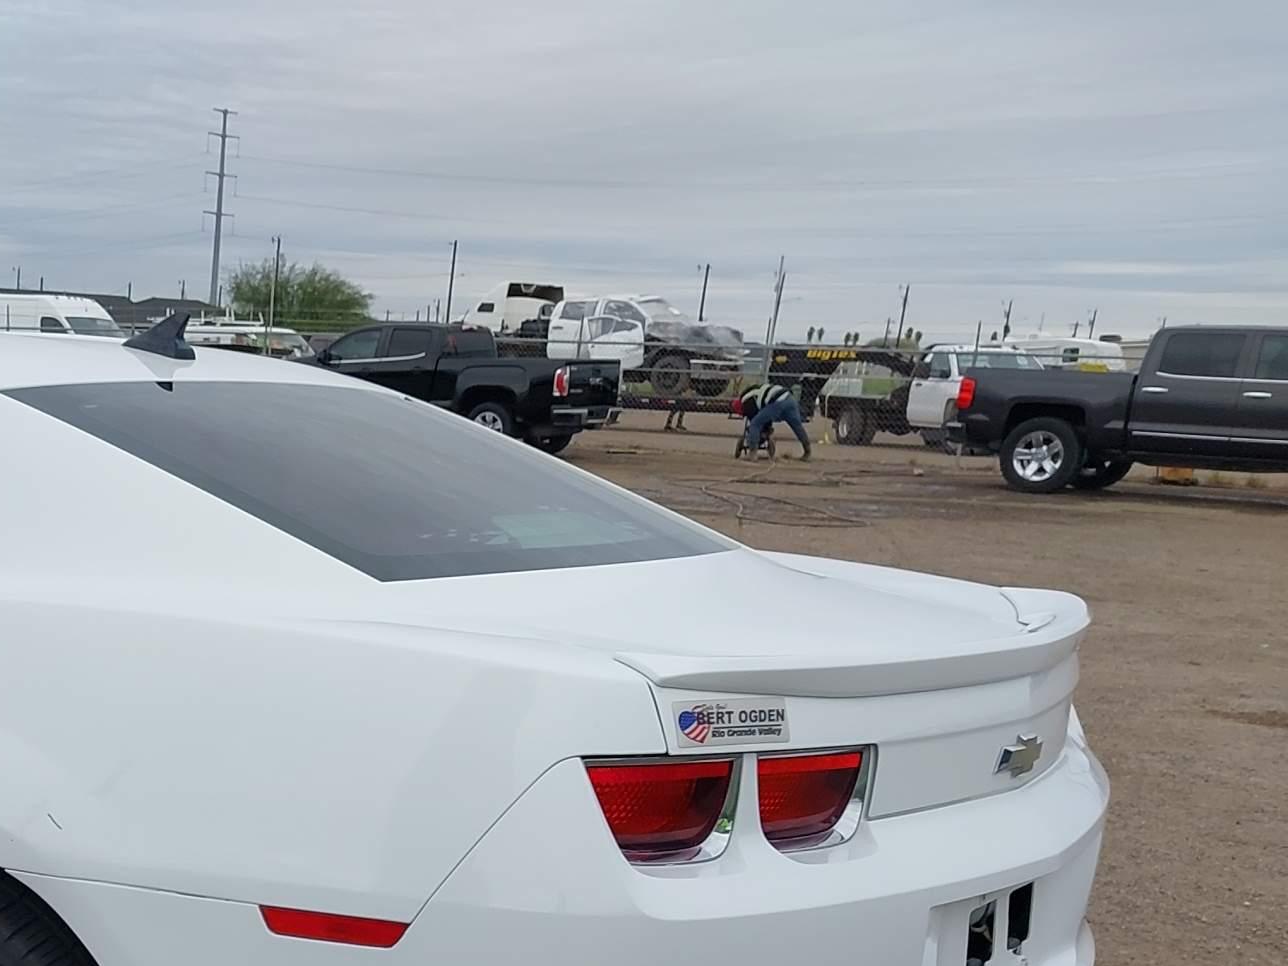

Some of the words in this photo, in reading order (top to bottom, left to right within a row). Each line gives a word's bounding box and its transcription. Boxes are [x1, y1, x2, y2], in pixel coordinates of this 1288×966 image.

[696, 710, 734, 725] BERT
[738, 708, 785, 723] OGDEN
[711, 729, 725, 738] Rio
